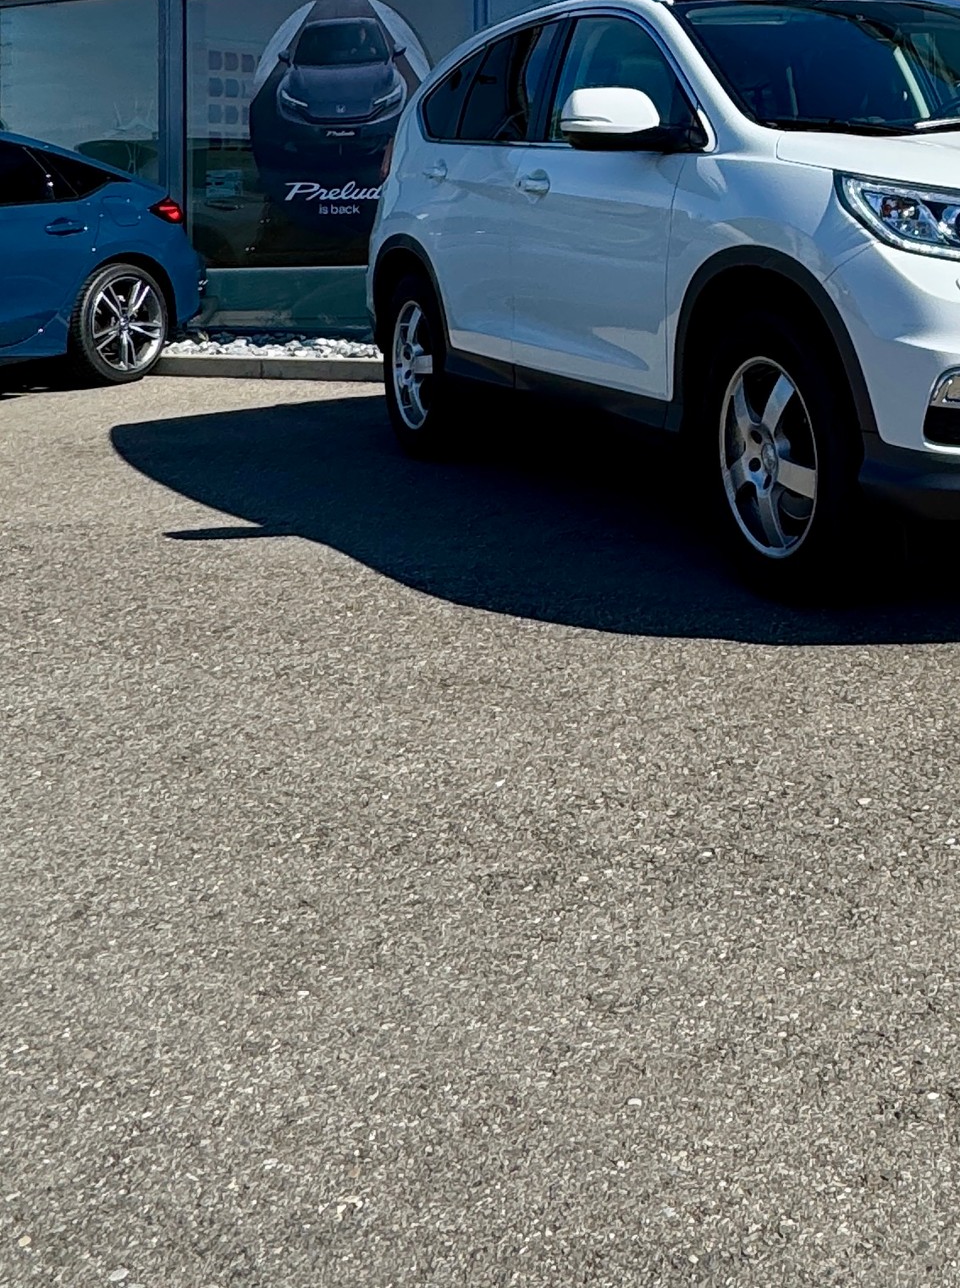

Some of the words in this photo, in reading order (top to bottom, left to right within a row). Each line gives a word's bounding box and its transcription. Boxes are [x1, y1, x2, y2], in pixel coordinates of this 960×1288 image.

[284, 180, 383, 201] Prelud
[319, 203, 329, 215] is
[330, 203, 361, 215] back
